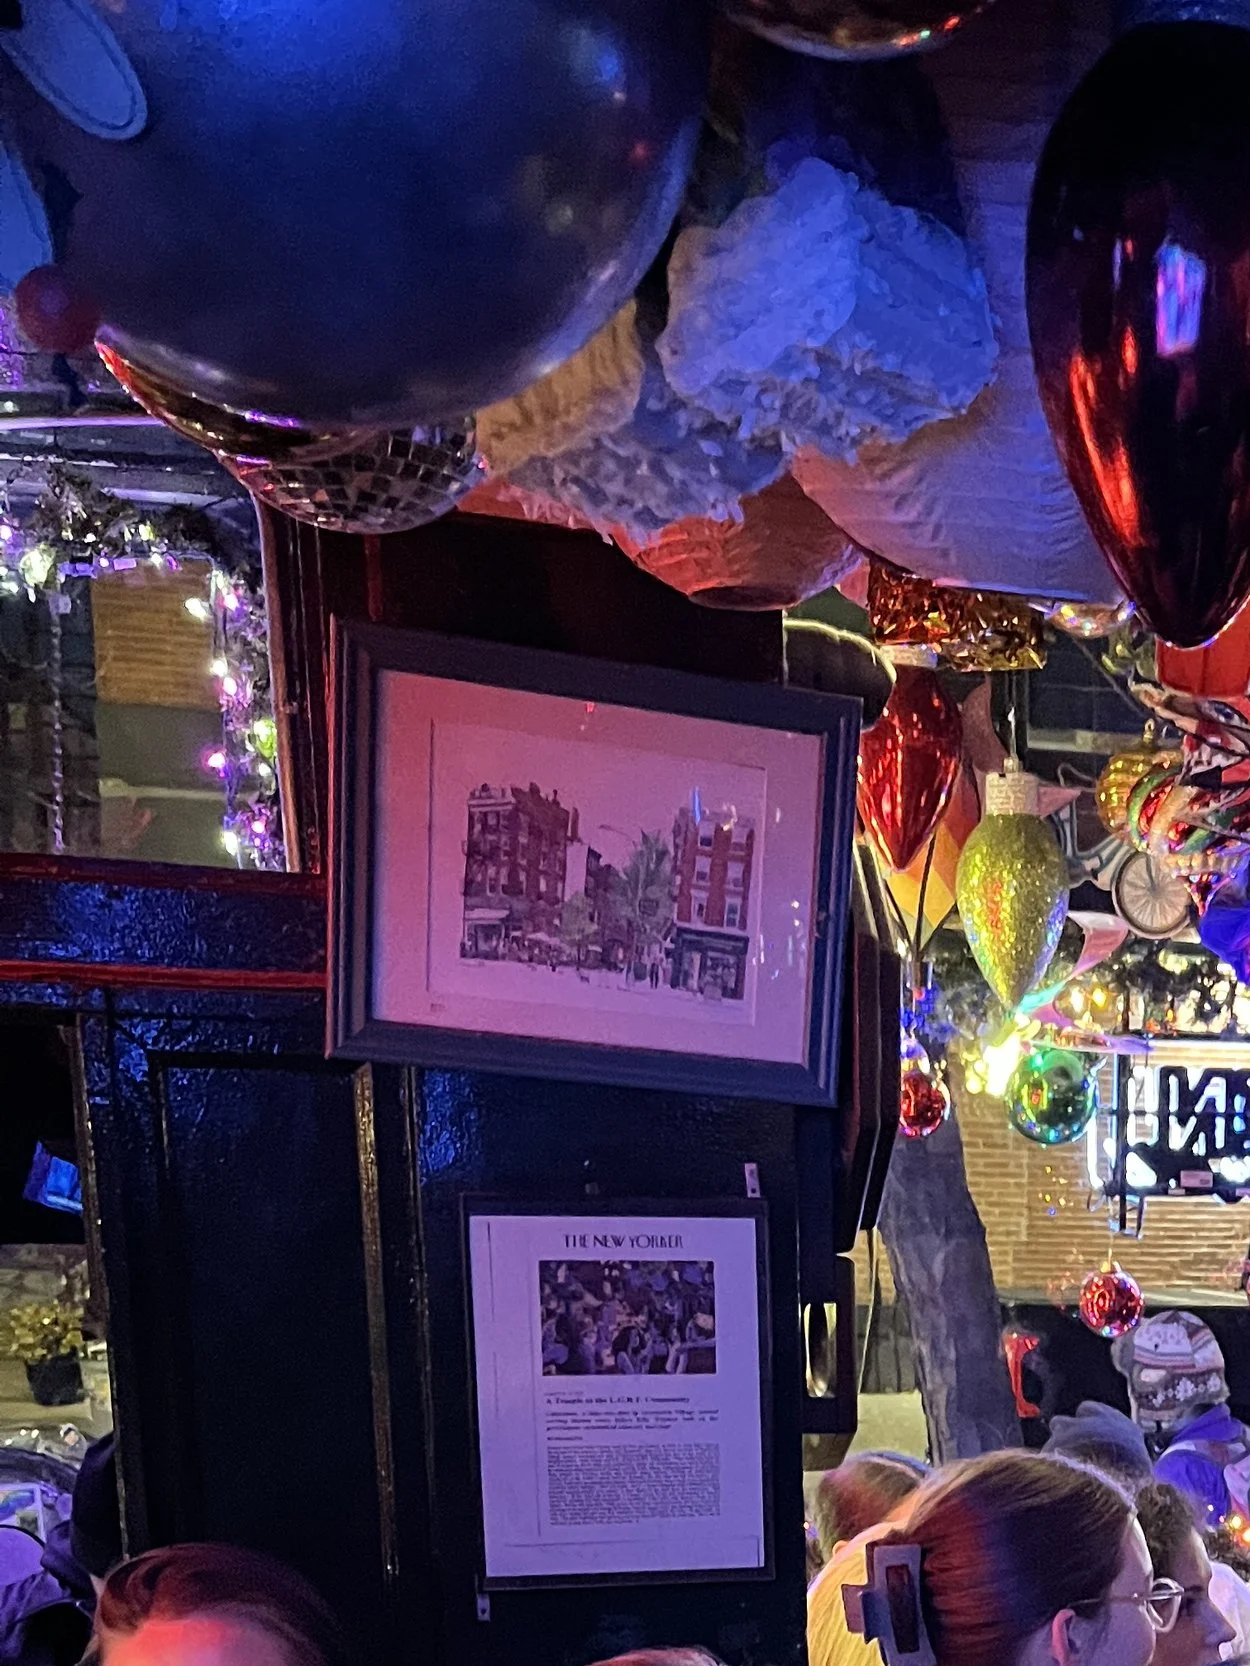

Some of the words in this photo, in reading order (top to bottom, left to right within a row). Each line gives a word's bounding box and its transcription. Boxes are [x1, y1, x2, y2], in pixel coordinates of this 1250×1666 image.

[563, 1234, 588, 1249] THE
[593, 1234, 625, 1249] NEW
[628, 1234, 684, 1249] YORKER
